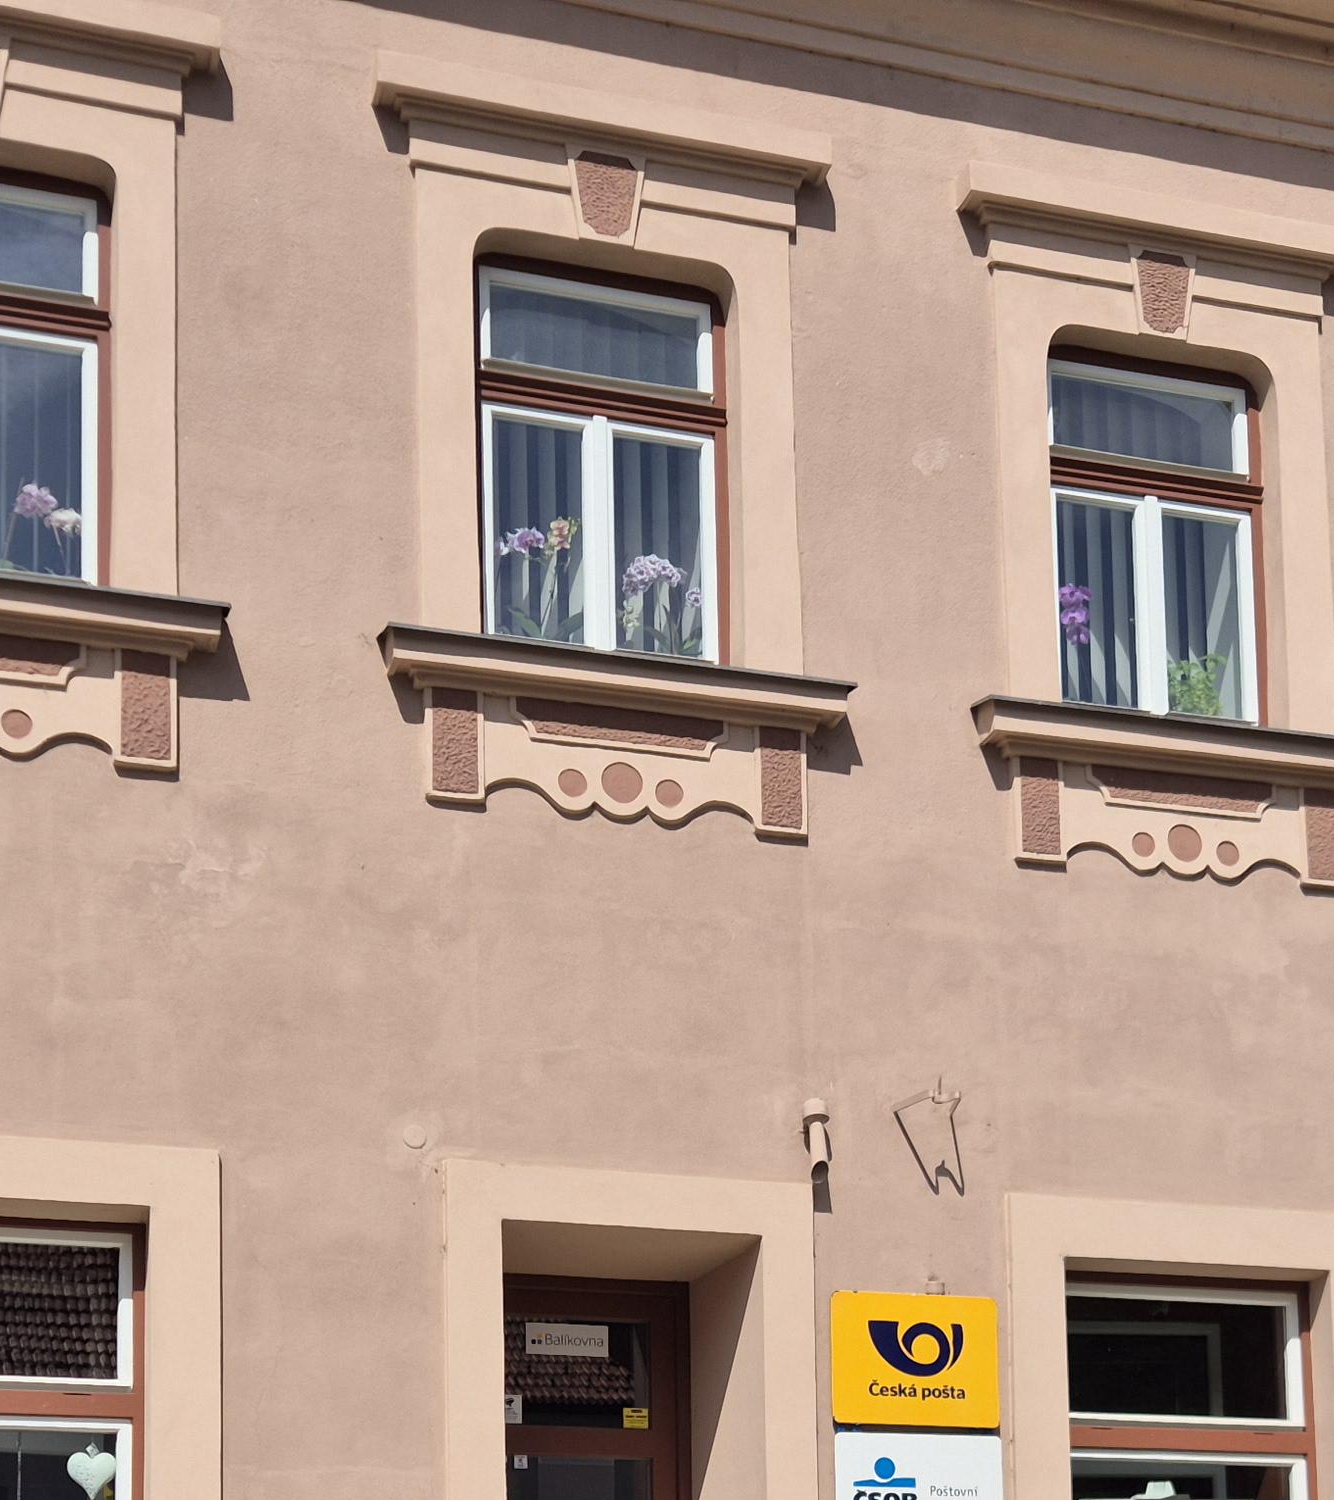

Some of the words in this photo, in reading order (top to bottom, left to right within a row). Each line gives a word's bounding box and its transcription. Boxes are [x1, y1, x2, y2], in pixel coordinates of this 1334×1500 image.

[545, 1333, 604, 1347] Balíkovna
[868, 1379, 917, 1397] Česká
[921, 1385, 966, 1401] pošta
[930, 1485, 978, 1497] Poštovní
